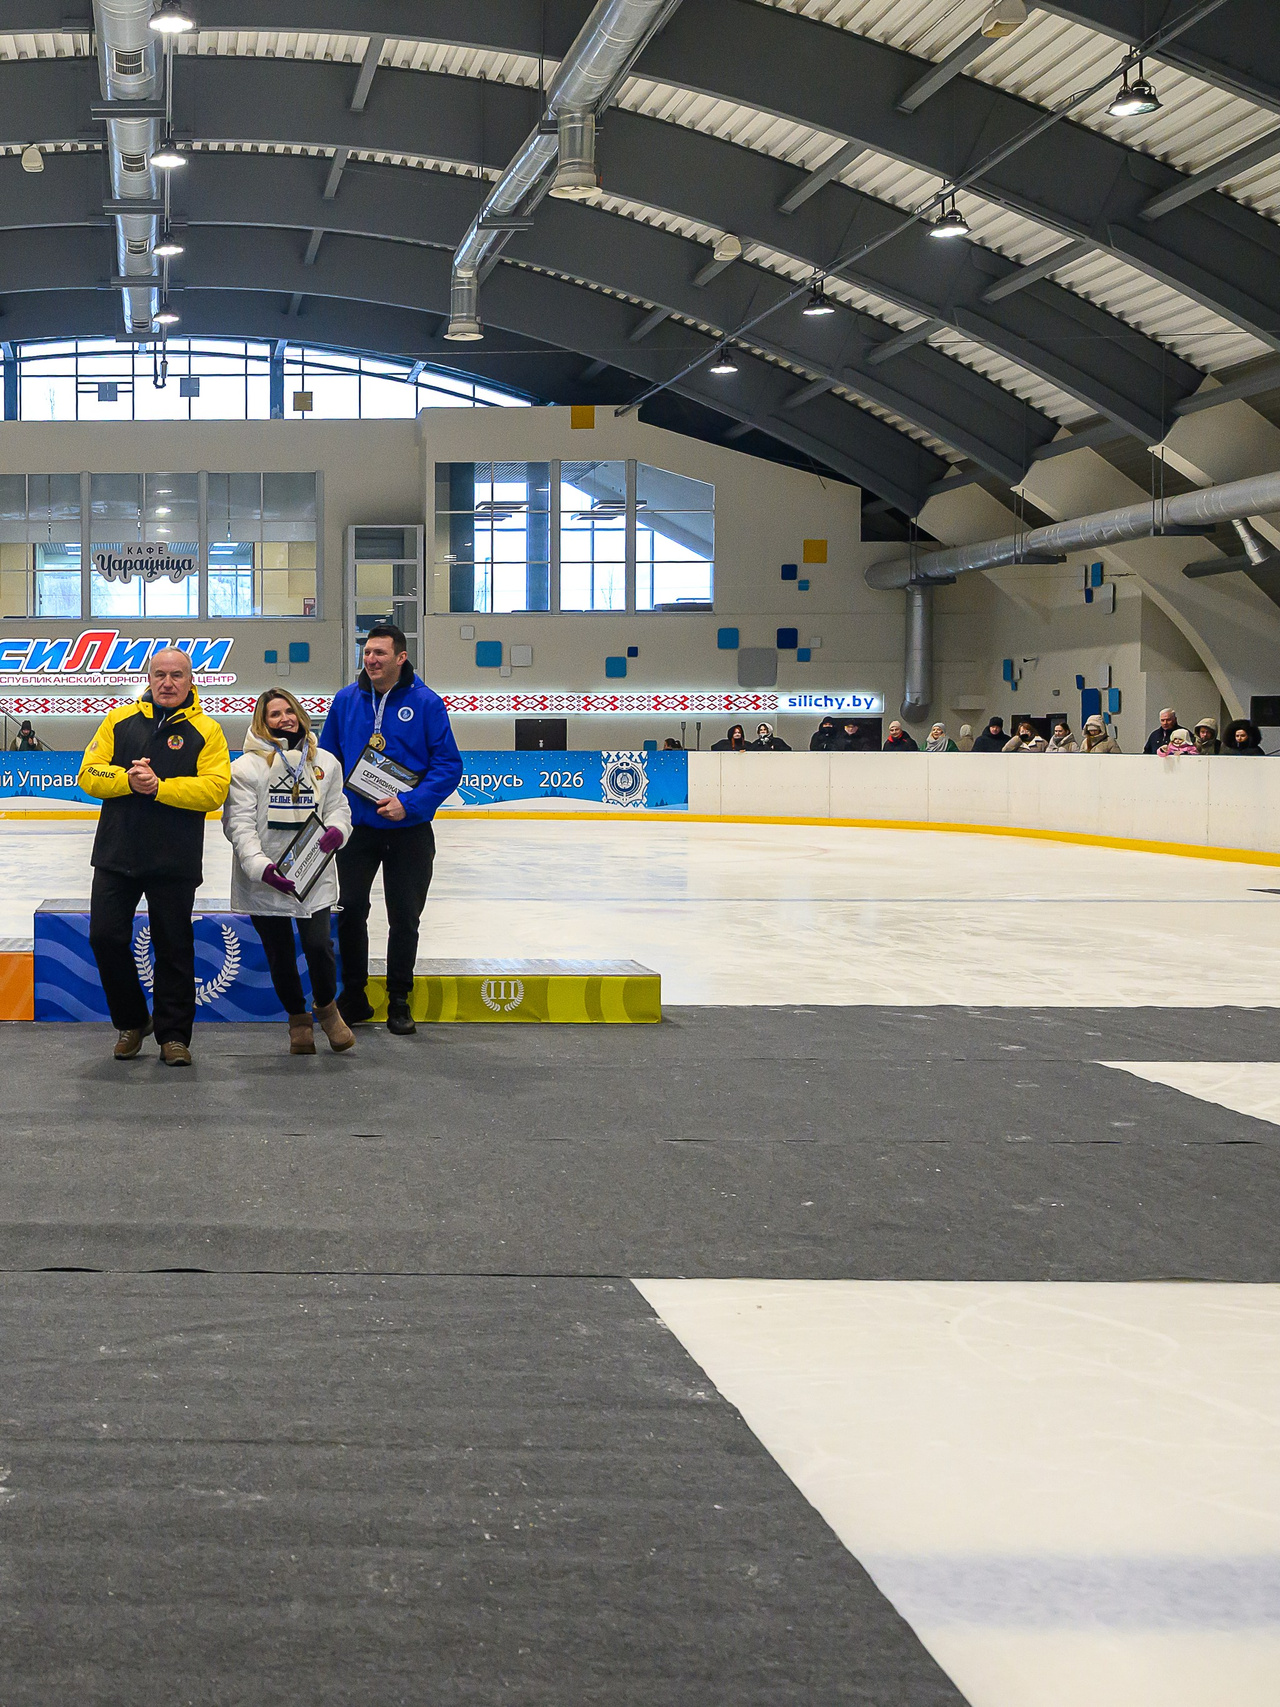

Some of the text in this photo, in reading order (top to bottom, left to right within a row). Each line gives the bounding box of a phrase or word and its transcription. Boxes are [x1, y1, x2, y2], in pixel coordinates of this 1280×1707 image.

[127, 546, 164, 555] КАФЕ
[198, 675, 234, 685] ЦЕНТР
[788, 695, 875, 710] silichy.by
[458, 774, 524, 792] ларусь
[539, 771, 584, 788] 2026
[488, 980, 518, 1000] III
